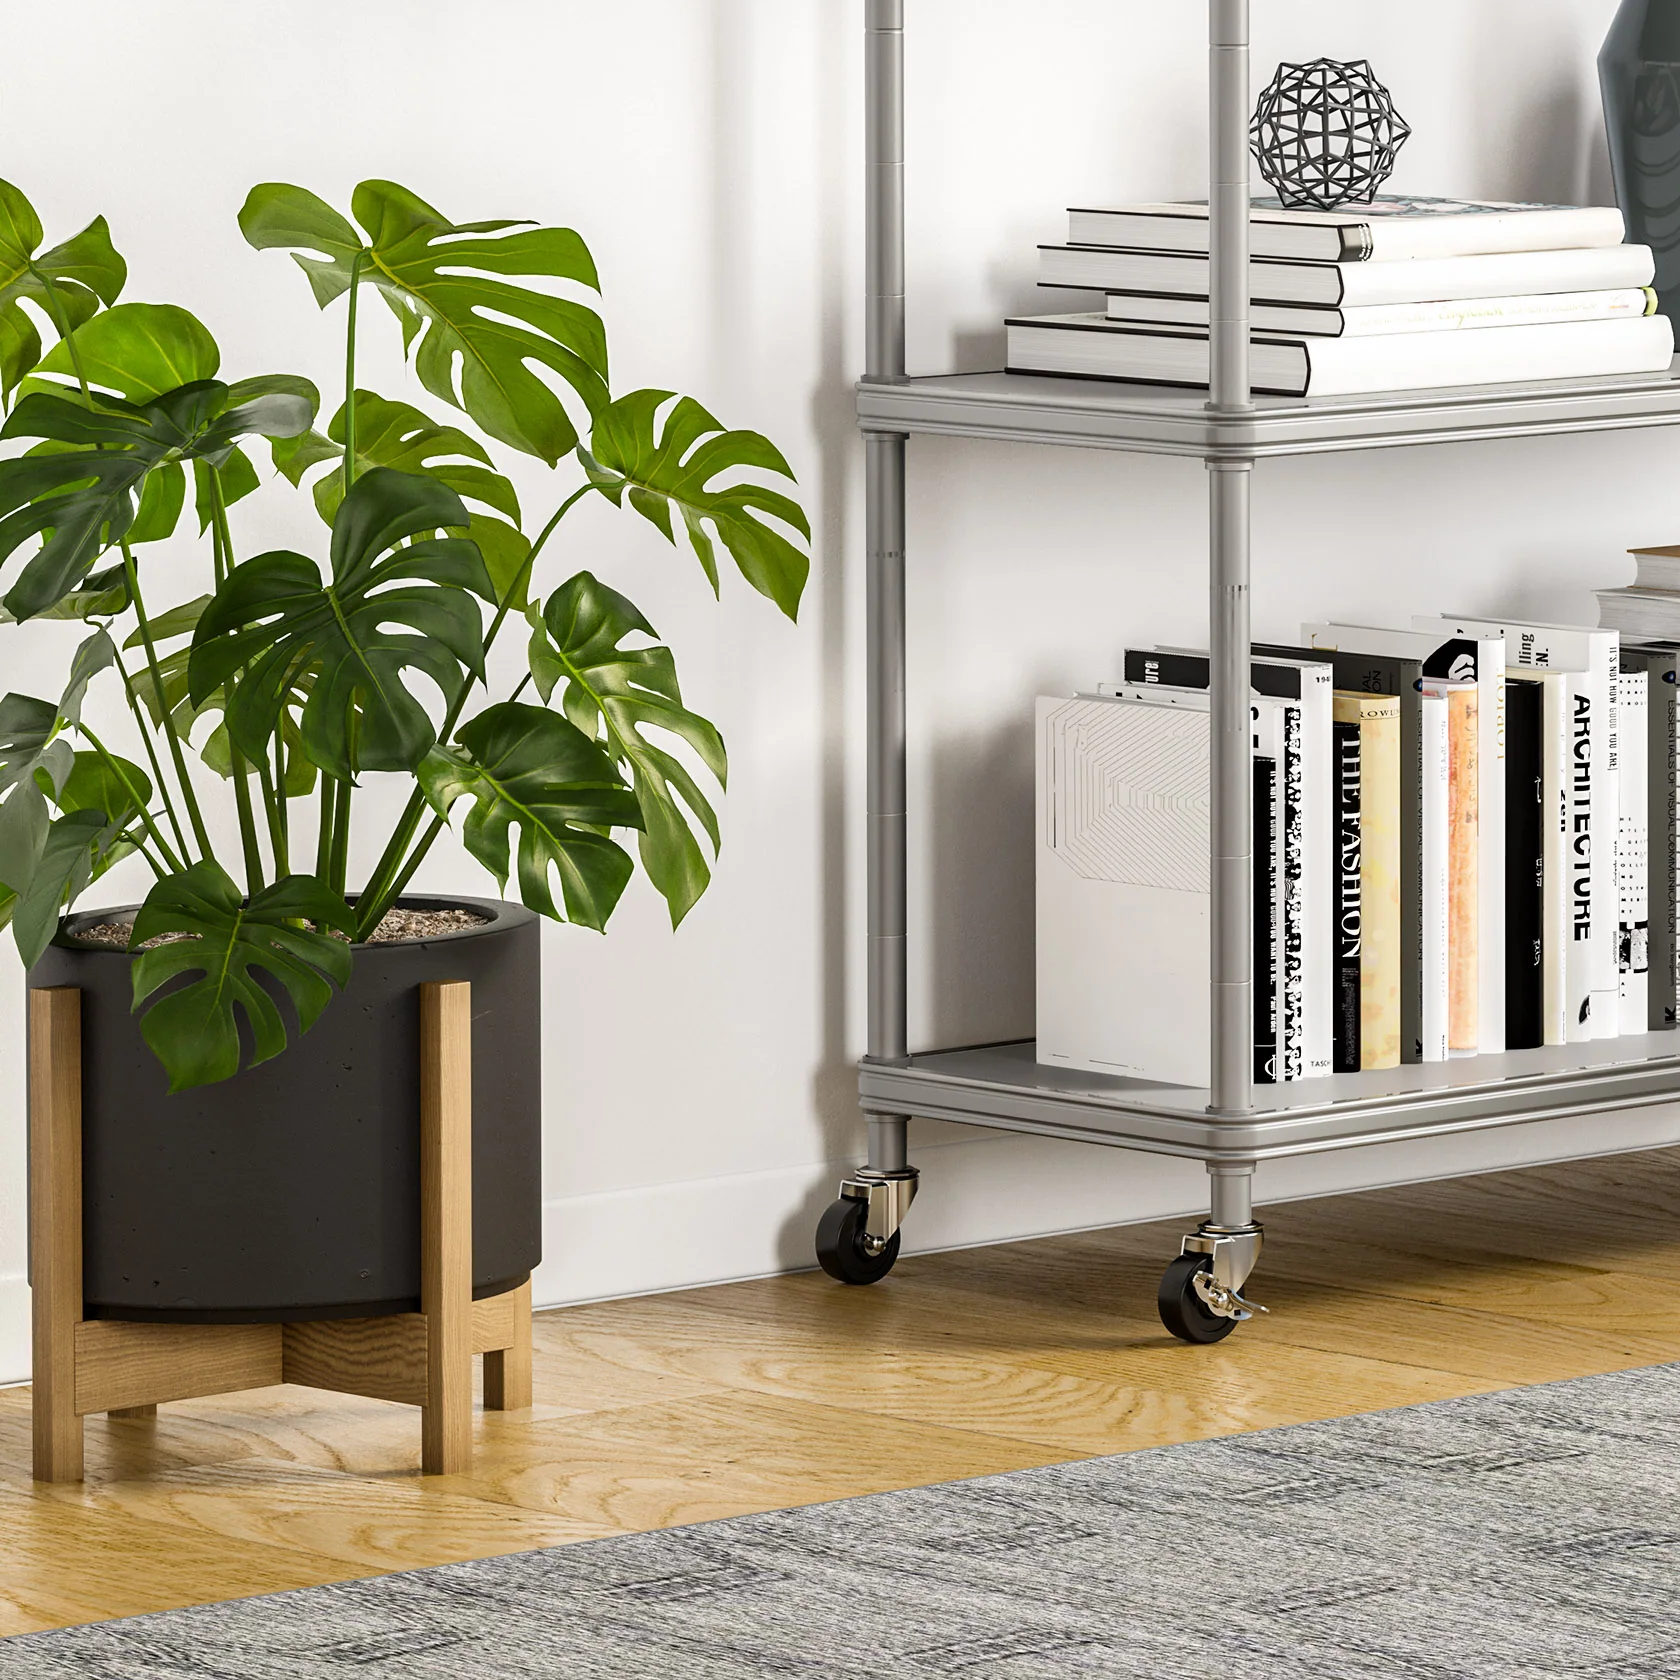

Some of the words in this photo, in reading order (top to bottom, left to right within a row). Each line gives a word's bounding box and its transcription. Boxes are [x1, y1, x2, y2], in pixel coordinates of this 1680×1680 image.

[1342, 731, 1360, 803] THE
[1668, 700, 1676, 769] ESSENTIALS
[1668, 772, 1676, 788] OF
[1668, 791, 1676, 831] VISUAL
[1574, 694, 1590, 942] ARCHITECTURE
[1342, 810, 1360, 958] FASHION
[1668, 834, 1676, 934] COMMUNICATION
